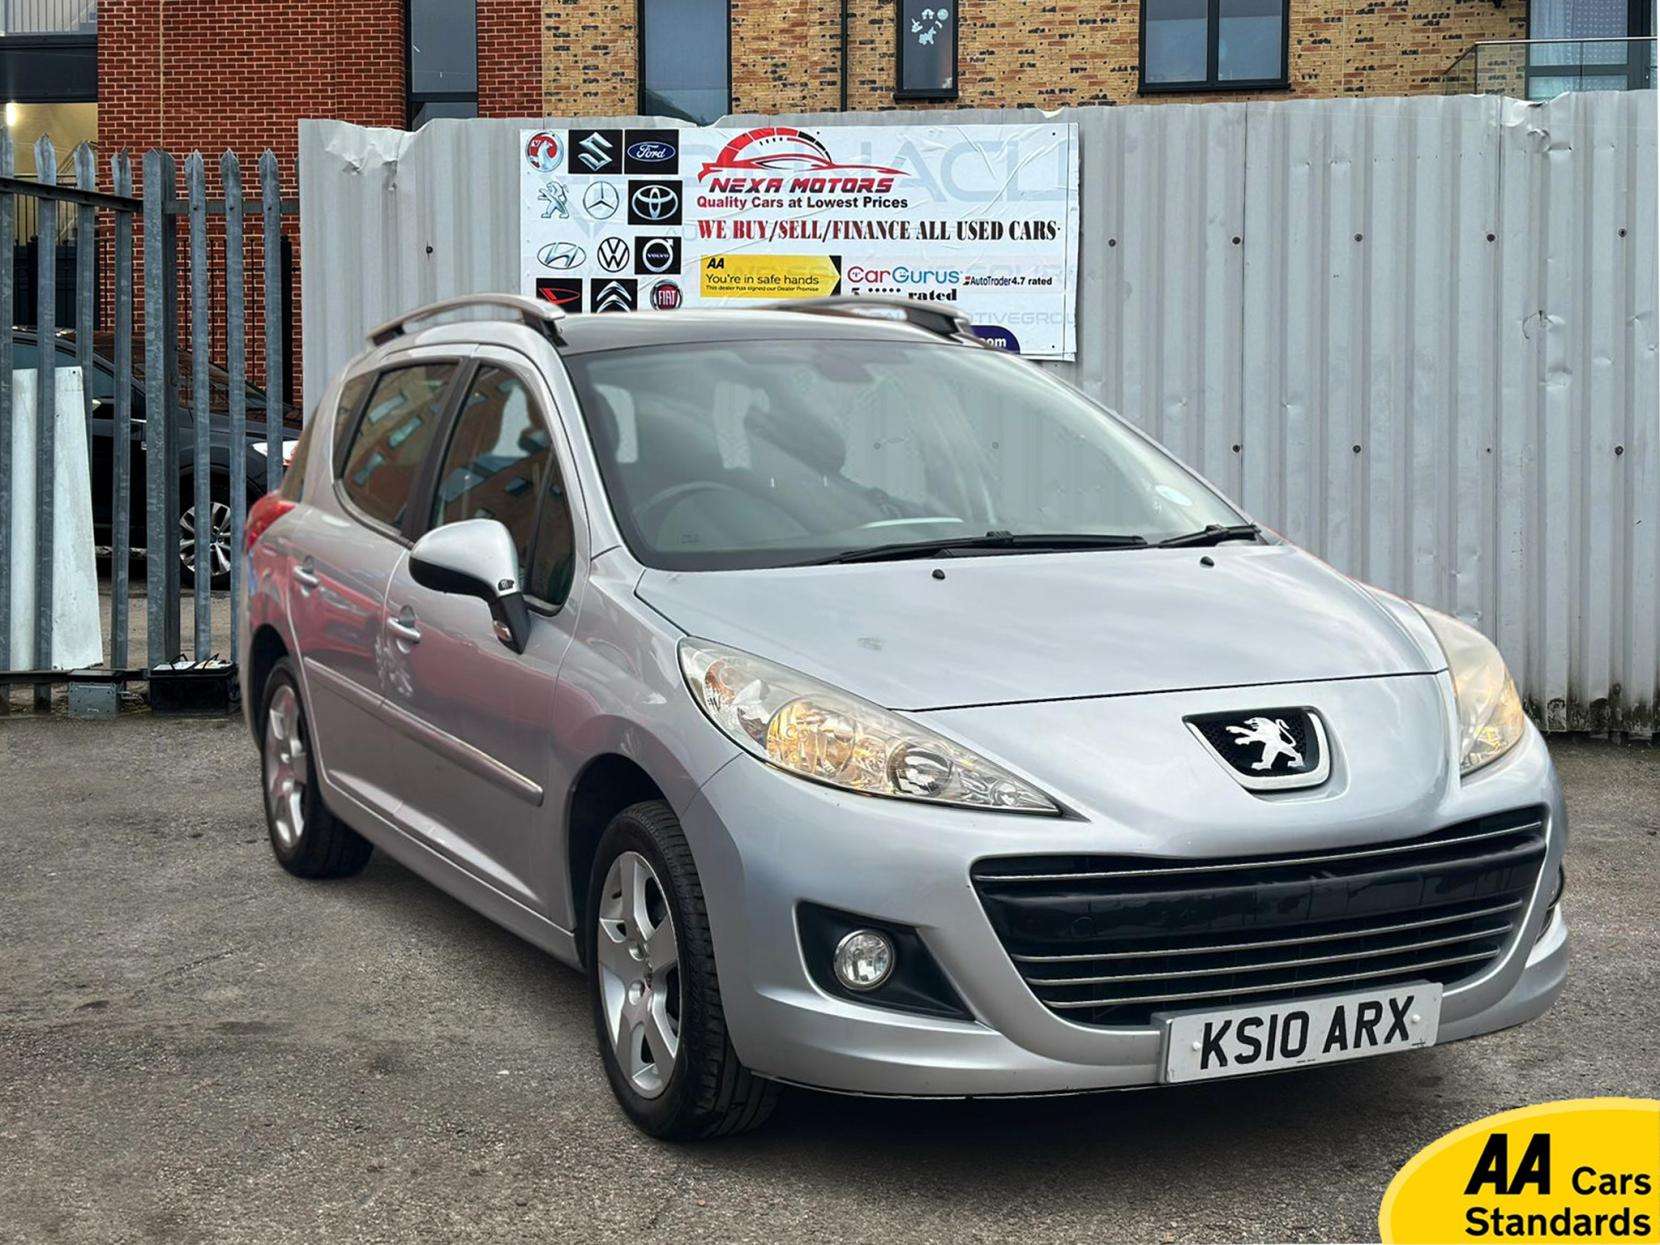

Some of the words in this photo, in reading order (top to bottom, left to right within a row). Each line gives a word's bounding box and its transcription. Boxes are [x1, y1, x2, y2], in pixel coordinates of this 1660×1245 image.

[636, 144, 666, 159] Ford
[708, 178, 784, 193] NEXA
[789, 178, 895, 193] MOTORS
[697, 196, 747, 210] Quality
[751, 196, 784, 208] Cars
[789, 197, 802, 208] at
[807, 196, 858, 208] Lowest
[863, 196, 908, 208] Prices
[697, 220, 727, 240] WE
[916, 220, 951, 240] ALL
[956, 220, 1003, 240] USED
[1008, 220, 1057, 240] CARS
[706, 257, 725, 269] AA
[706, 274, 741, 284] You're
[744, 274, 754, 284] in
[757, 274, 781, 284] safe
[784, 275, 819, 285] hands
[847, 266, 960, 284] CarGurus
[1028, 277, 1053, 286] rated
[658, 290, 677, 305] FIAT
[908, 289, 957, 301] rated
[1200, 1011, 1310, 1070] KS10
[1322, 995, 1415, 1054] ARX
